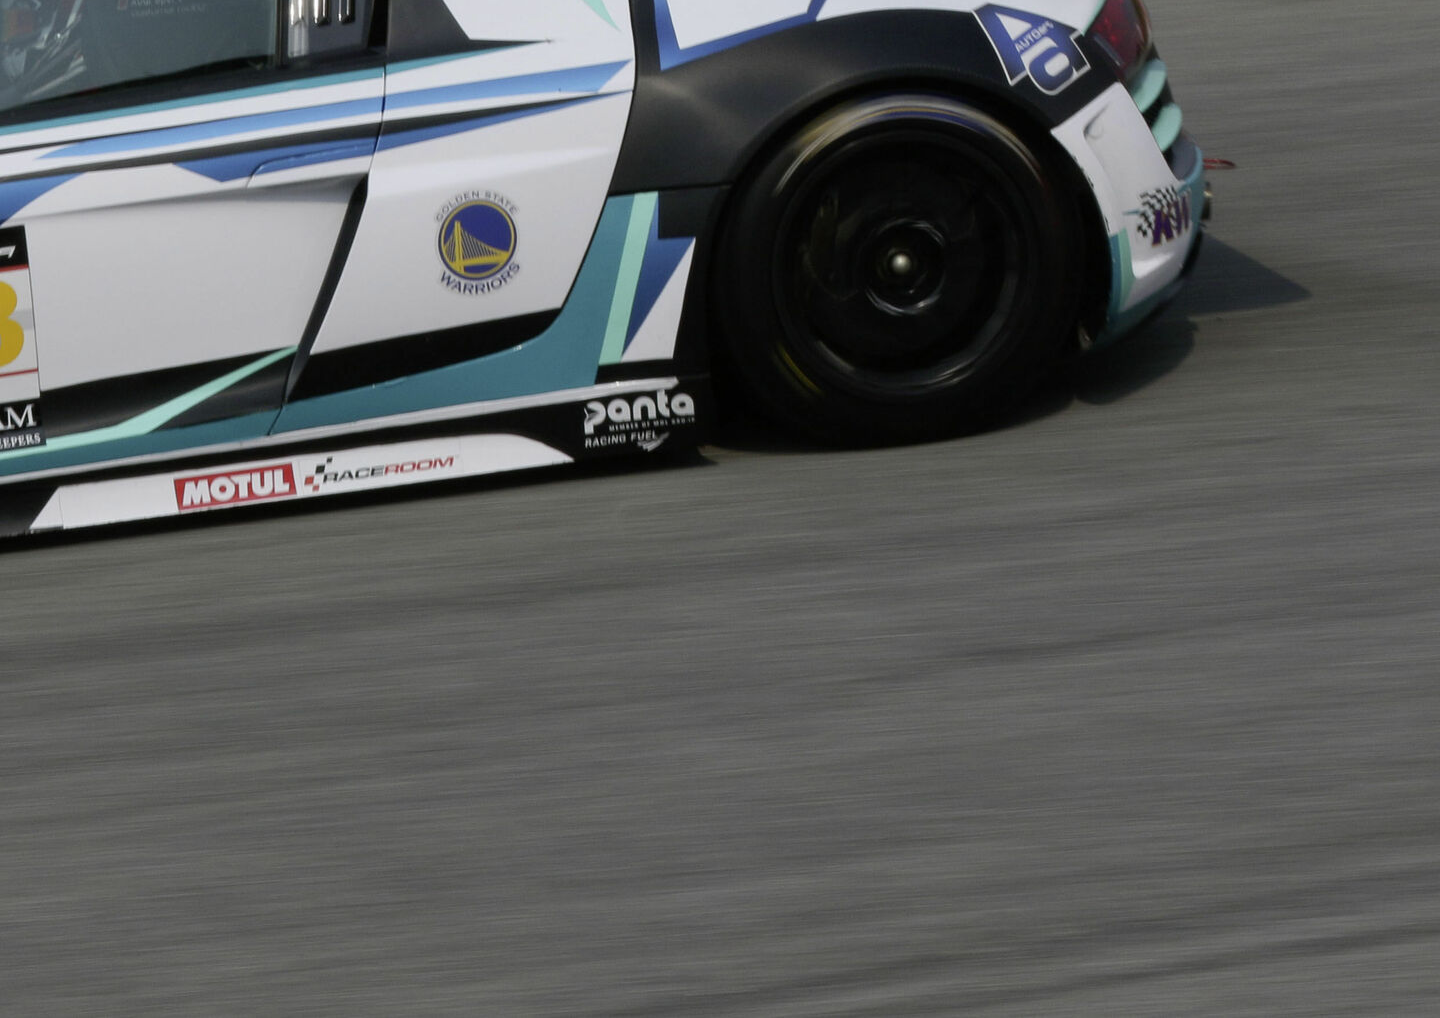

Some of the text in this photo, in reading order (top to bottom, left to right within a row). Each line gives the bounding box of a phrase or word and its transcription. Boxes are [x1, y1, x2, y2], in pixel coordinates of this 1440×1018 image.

[435, 190, 519, 222] GOLDEN STATE
[440, 262, 521, 295] WARRIORS
[583, 388, 696, 436] panta
[584, 429, 657, 449] RACING FUEL
[181, 456, 455, 507] MOTUL RACEROOM
